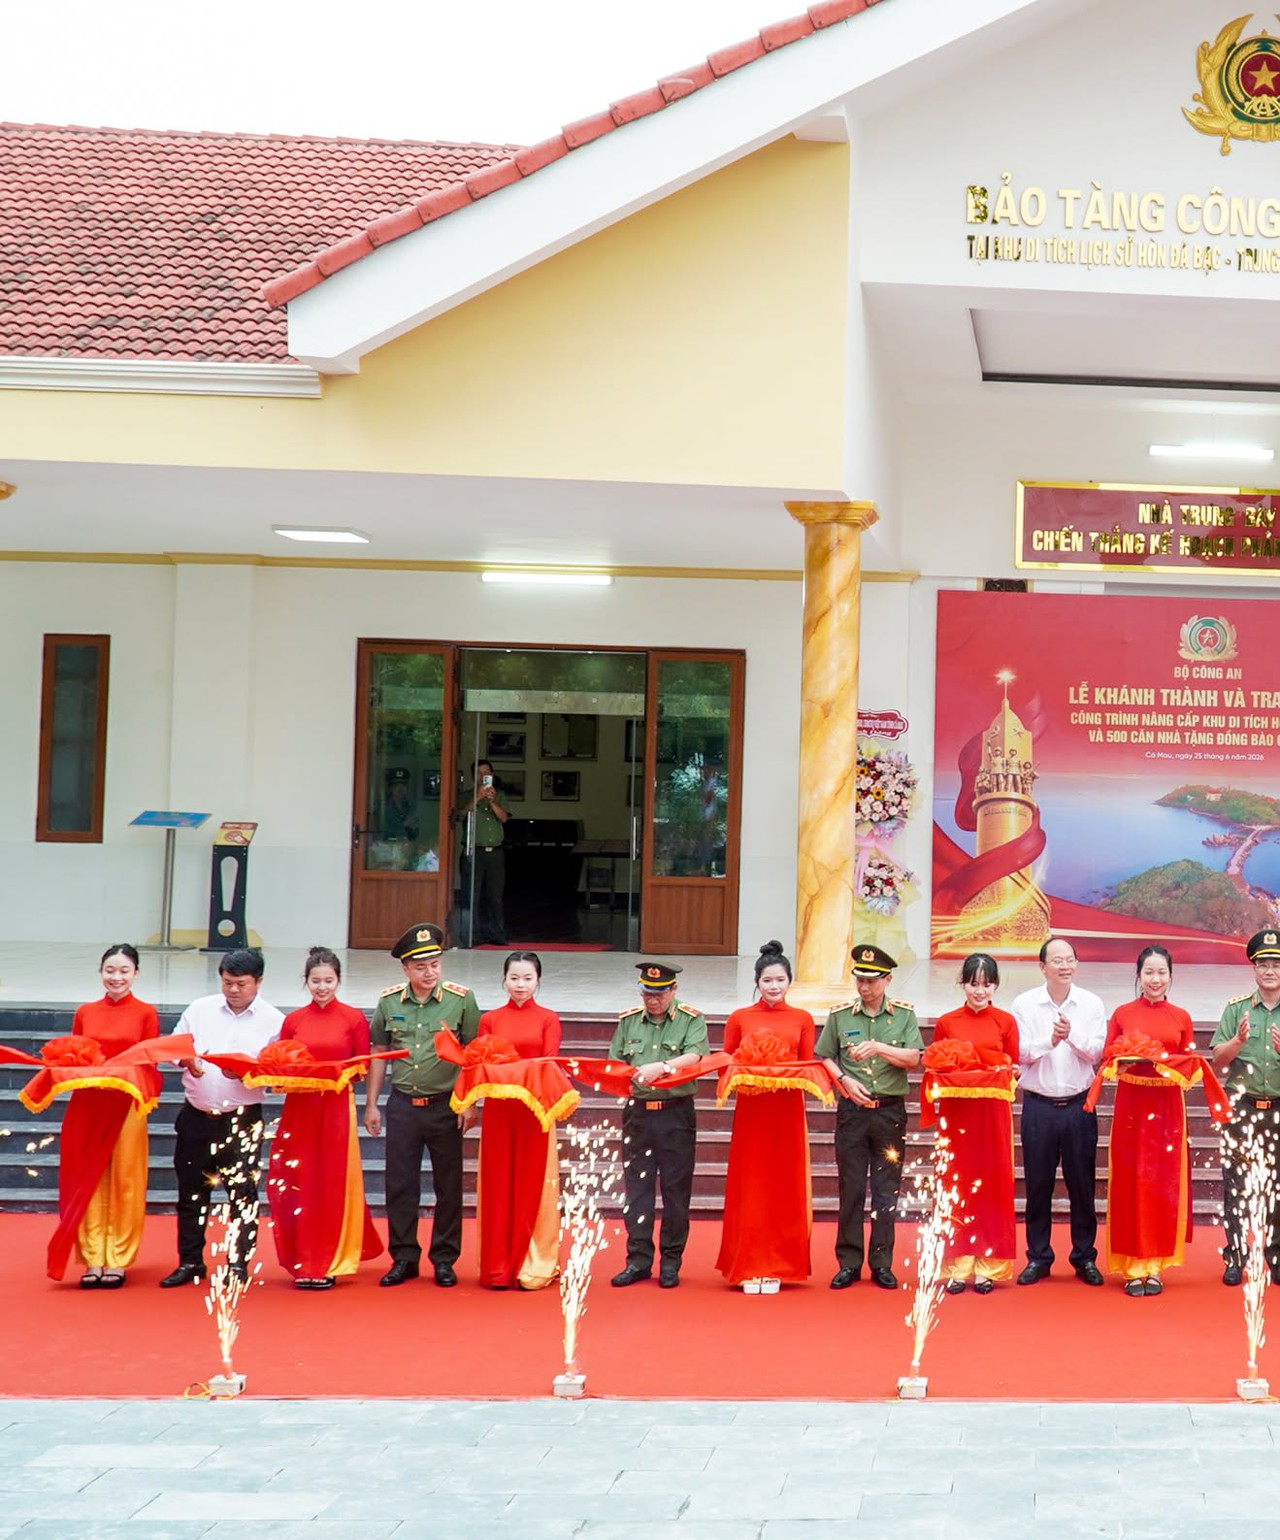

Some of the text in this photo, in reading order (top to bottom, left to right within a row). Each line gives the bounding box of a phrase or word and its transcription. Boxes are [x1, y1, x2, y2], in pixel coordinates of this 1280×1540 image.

[966, 171, 1047, 227] BẢO
[1058, 180, 1166, 232] TÀNG
[966, 235, 989, 266] TẠI
[994, 236, 1022, 261] KHU
[1026, 238, 1040, 262] DI
[1044, 235, 1076, 264] TÍCH
[1079, 239, 1111, 271] LỊCH
[1115, 233, 1135, 267] SỬ
[1137, 238, 1166, 269] HÒN
[1170, 239, 1189, 269] ĐÁ
[1193, 244, 1221, 275] BẠC
[1236, 247, 1280, 273] TRUNG
[1137, 499, 1173, 525] NHÀ
[1032, 524, 1084, 552] CHIẾN
[1088, 524, 1146, 554] THẮNG
[1149, 528, 1174, 555] KẾ
[1173, 664, 1242, 681] BỘ CÔNG AN
[1069, 681, 1089, 705] LỄ
[1094, 684, 1155, 706] KHÁNH
[1160, 686, 1218, 707] THÀNH
[1223, 687, 1246, 708] VÀ
[1070, 710, 1102, 725] CÔNG
[1105, 710, 1139, 726] TRÌNH
[1141, 711, 1174, 727] NÂNG
[1176, 710, 1200, 727] CẤP
[1202, 715, 1226, 728] KHU
[1228, 716, 1240, 728] DI
[1243, 714, 1269, 729] TÍCH
[1088, 727, 1104, 743] VÀ
[1106, 730, 1128, 743] 500
[1130, 728, 1155, 744] CĂN
[1157, 729, 1181, 744] NHÀ
[1184, 730, 1214, 747] TẶNG
[1250, 731, 1274, 746] BÀO
